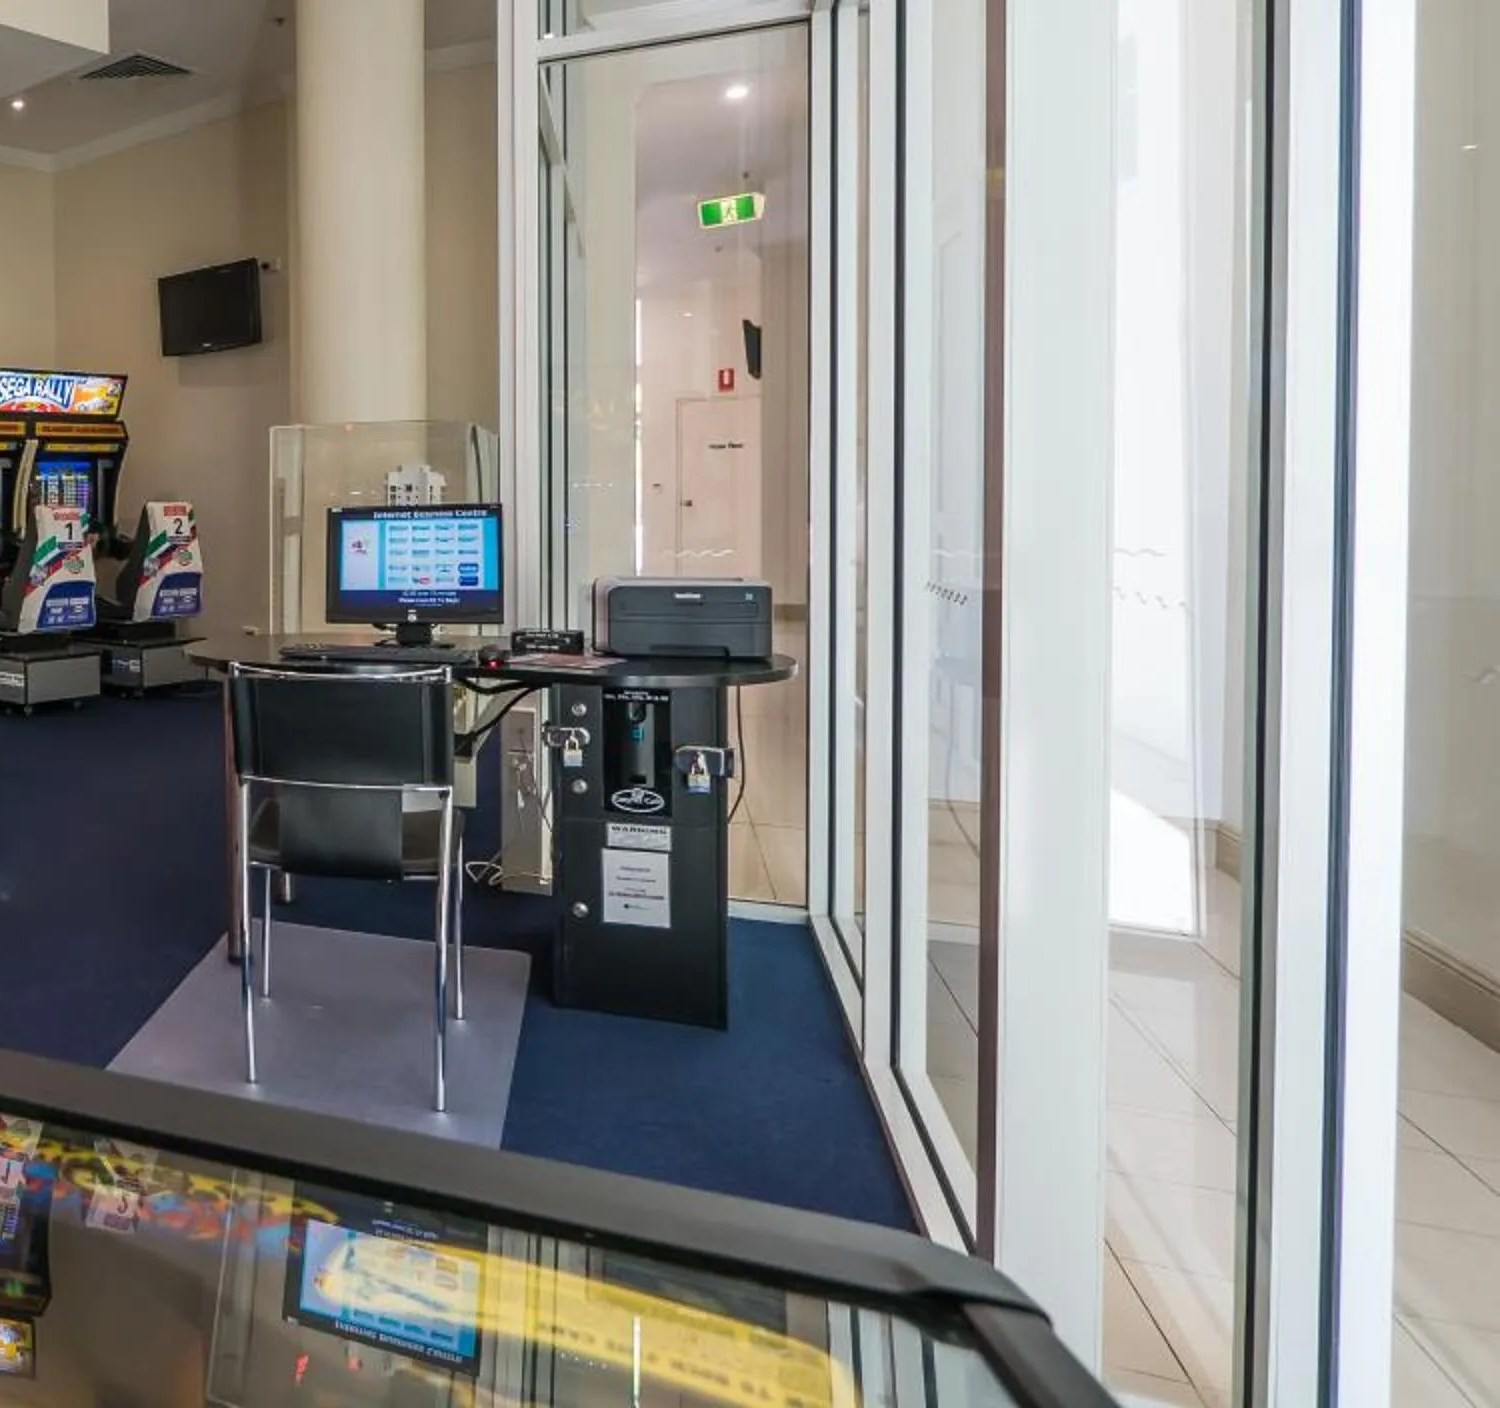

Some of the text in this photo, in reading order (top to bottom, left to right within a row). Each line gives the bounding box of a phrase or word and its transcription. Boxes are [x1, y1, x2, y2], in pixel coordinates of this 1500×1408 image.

[34, 376, 75, 408] RALLY
[64, 522, 74, 541] 1
[172, 517, 185, 535] 2
